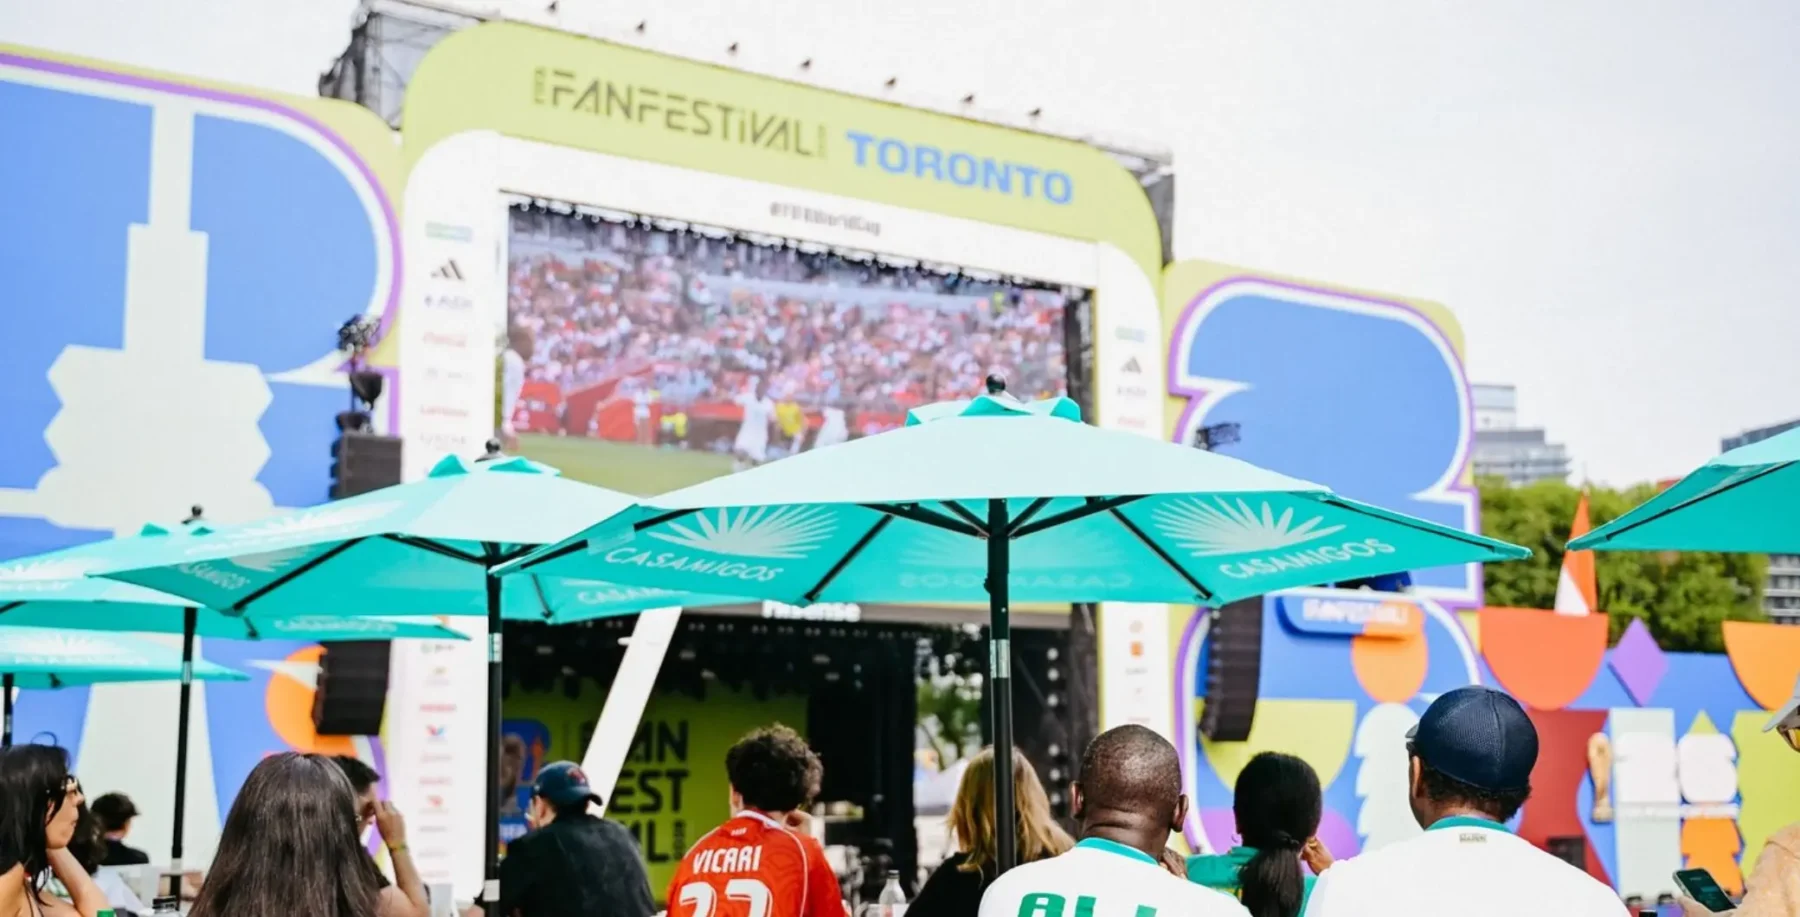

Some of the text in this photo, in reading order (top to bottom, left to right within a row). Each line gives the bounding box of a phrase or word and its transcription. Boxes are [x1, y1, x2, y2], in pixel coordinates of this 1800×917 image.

[845, 128, 1075, 206] TORONTO
[604, 546, 784, 582] CASAMIGOS
[1218, 537, 1396, 580] CASAMIGOS
[693, 846, 763, 874] VICARI
